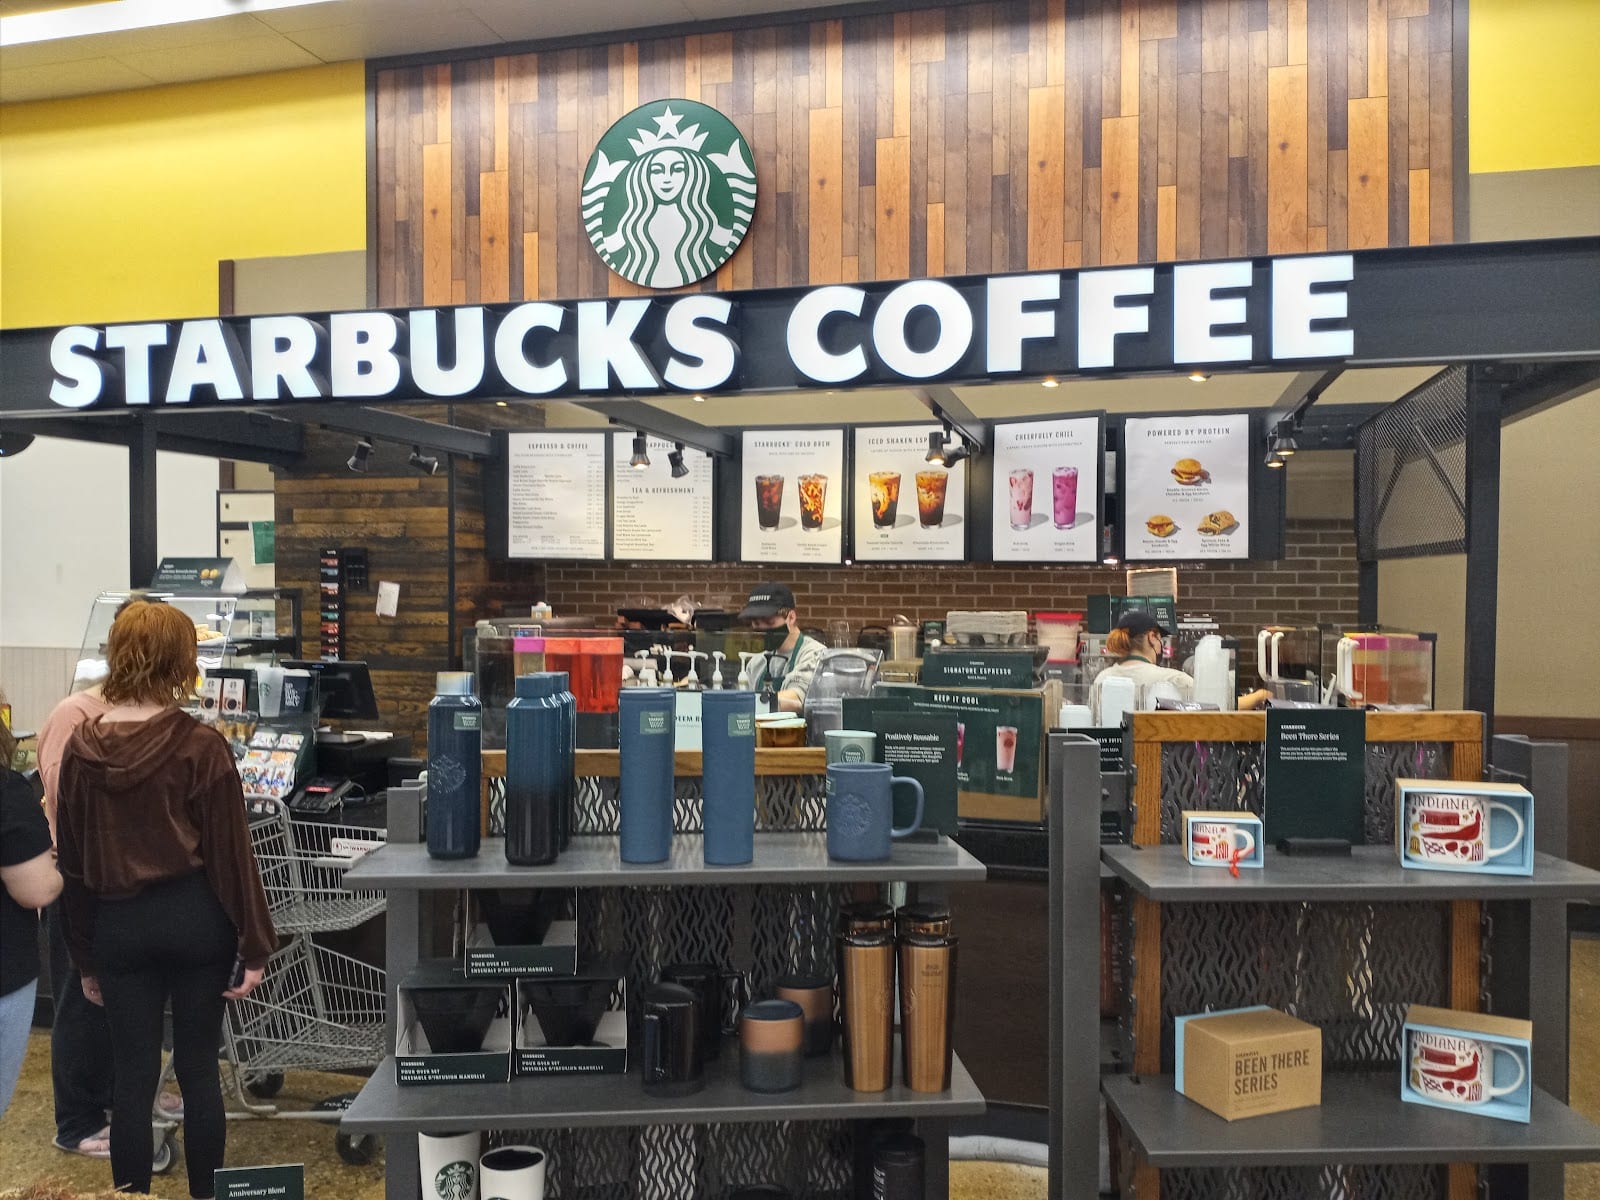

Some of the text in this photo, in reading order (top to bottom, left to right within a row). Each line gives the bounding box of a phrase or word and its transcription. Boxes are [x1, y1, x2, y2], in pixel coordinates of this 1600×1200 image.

[49, 254, 1354, 408] STARBUCKS COFFEE
[1015, 430, 1073, 441] CHEERFULLY CHILL
[1147, 428, 1182, 437] POWERED
[1197, 427, 1230, 435] PROTEIN
[794, 440, 811, 448] COLD
[943, 666, 1012, 675] SIGNATURE ESPRESSO
[933, 694, 979, 705] KEEP IT COOL
[885, 733, 940, 742] Positively Reusable
[1280, 732, 1340, 740] Been There Series
[1413, 794, 1469, 810] INDIANA
[1415, 1031, 1467, 1052] INDIANA
[1235, 1048, 1310, 1077] BEEN THERE
[1234, 1072, 1278, 1096] SERIES
[228, 1186, 286, 1198] Anniversary Blend
